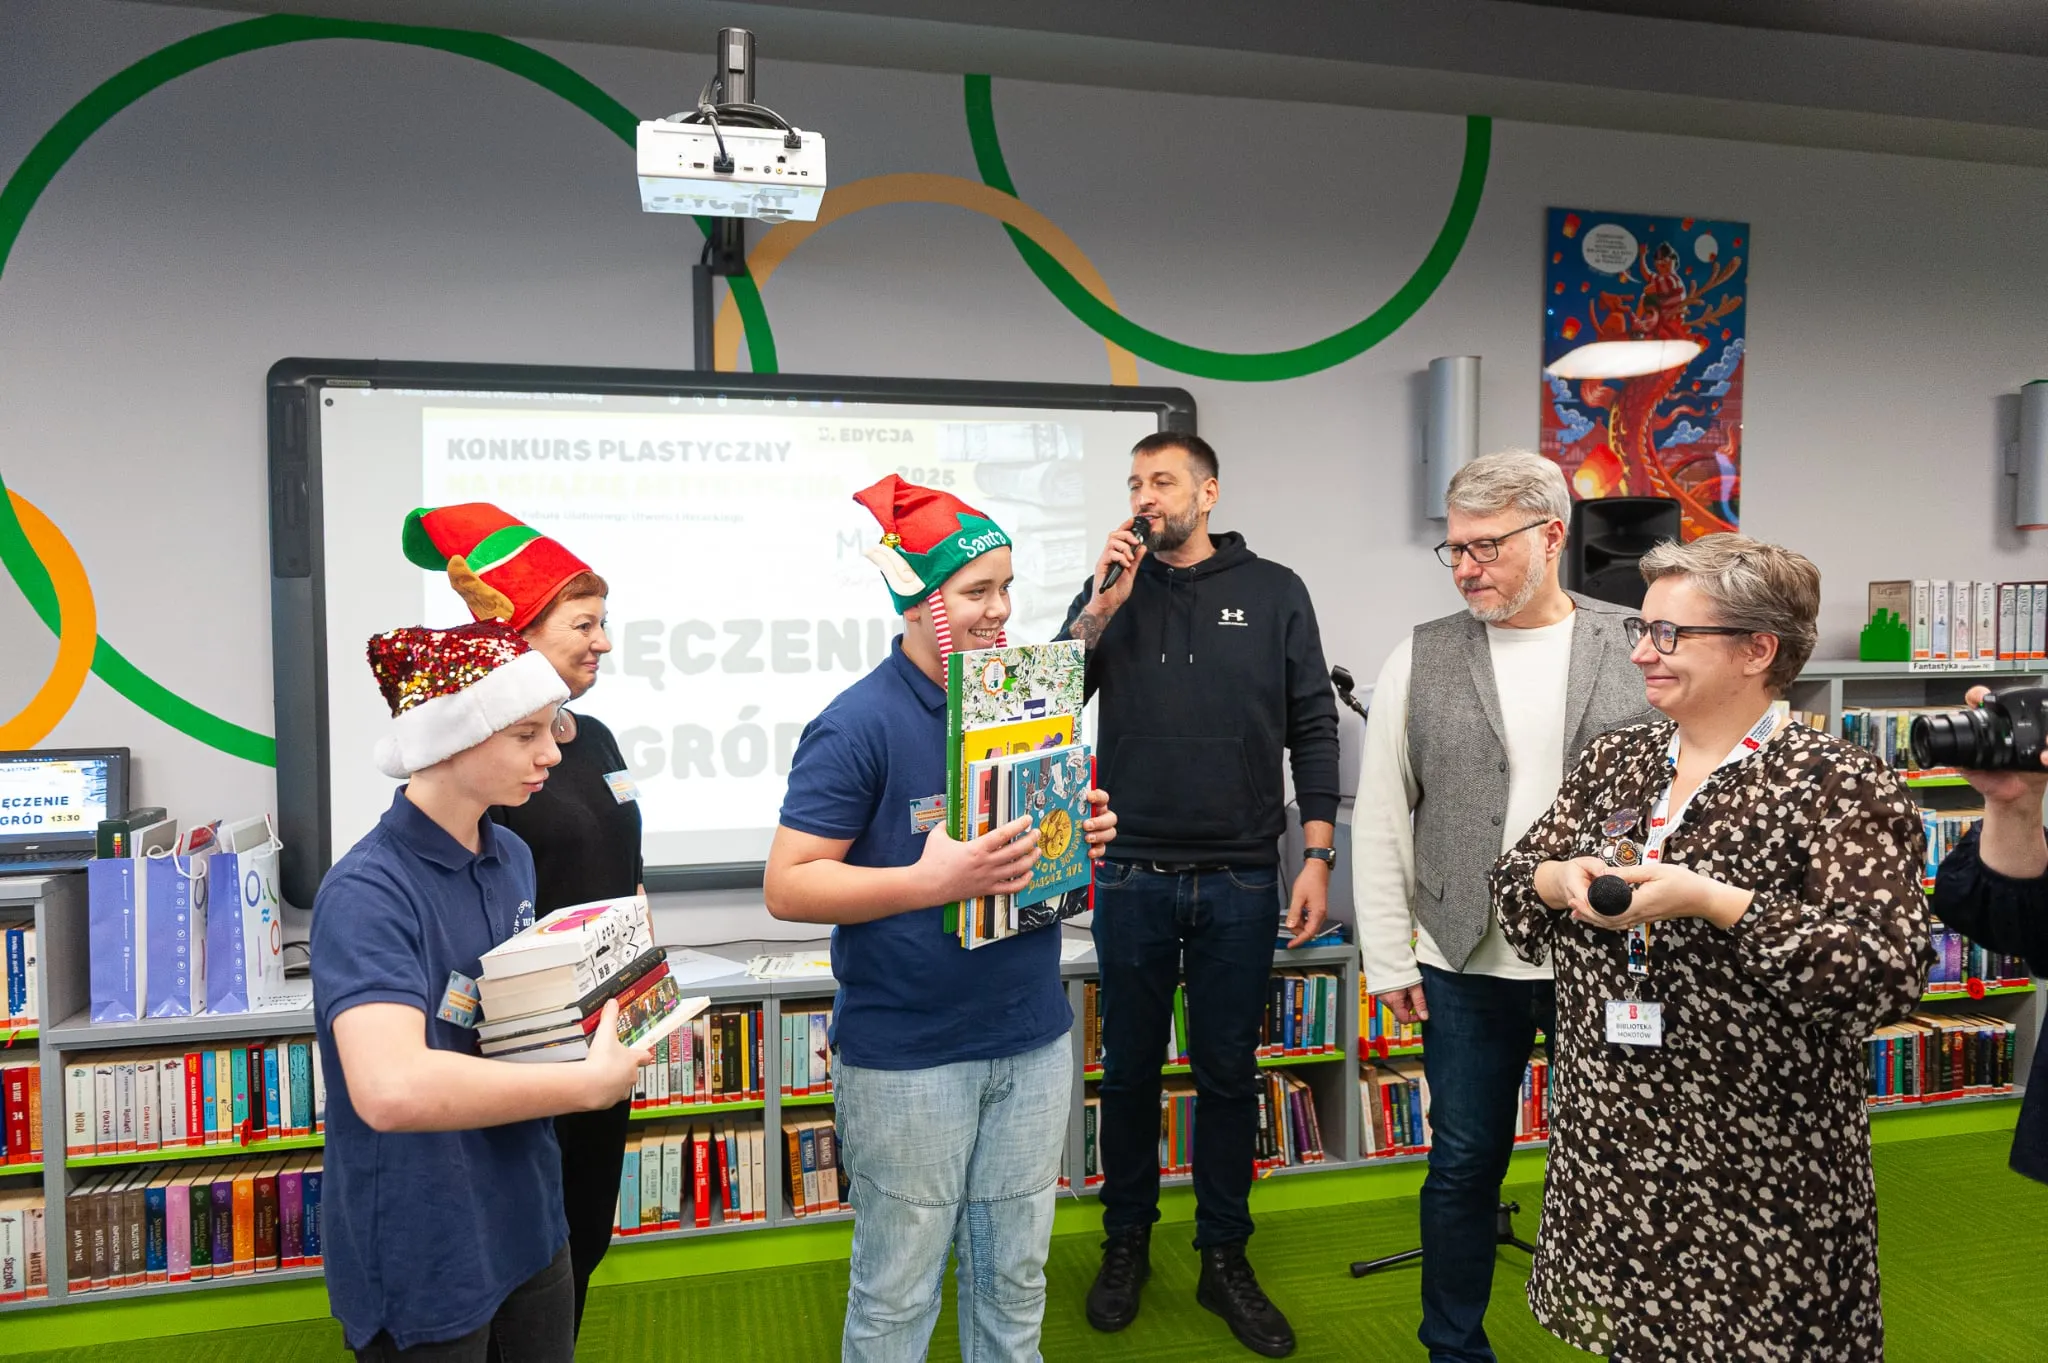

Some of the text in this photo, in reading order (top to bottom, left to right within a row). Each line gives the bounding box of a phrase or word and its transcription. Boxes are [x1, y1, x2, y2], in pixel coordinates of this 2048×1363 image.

[840, 428, 914, 443] EDYCJA
[446, 438, 792, 463] KONKURS PLASTYCZNY
[896, 465, 956, 487] 2025
[958, 529, 1006, 558] Santa
[600, 617, 905, 691] ĘCZENI
[1913, 662, 1958, 671] Fantastyka
[2, 796, 70, 811] ĘCZENIE
[0, 812, 80, 826] GRÓD 13:30
[74, 1112, 85, 1134] NORA
[30, 1252, 42, 1285] MOTYLE
